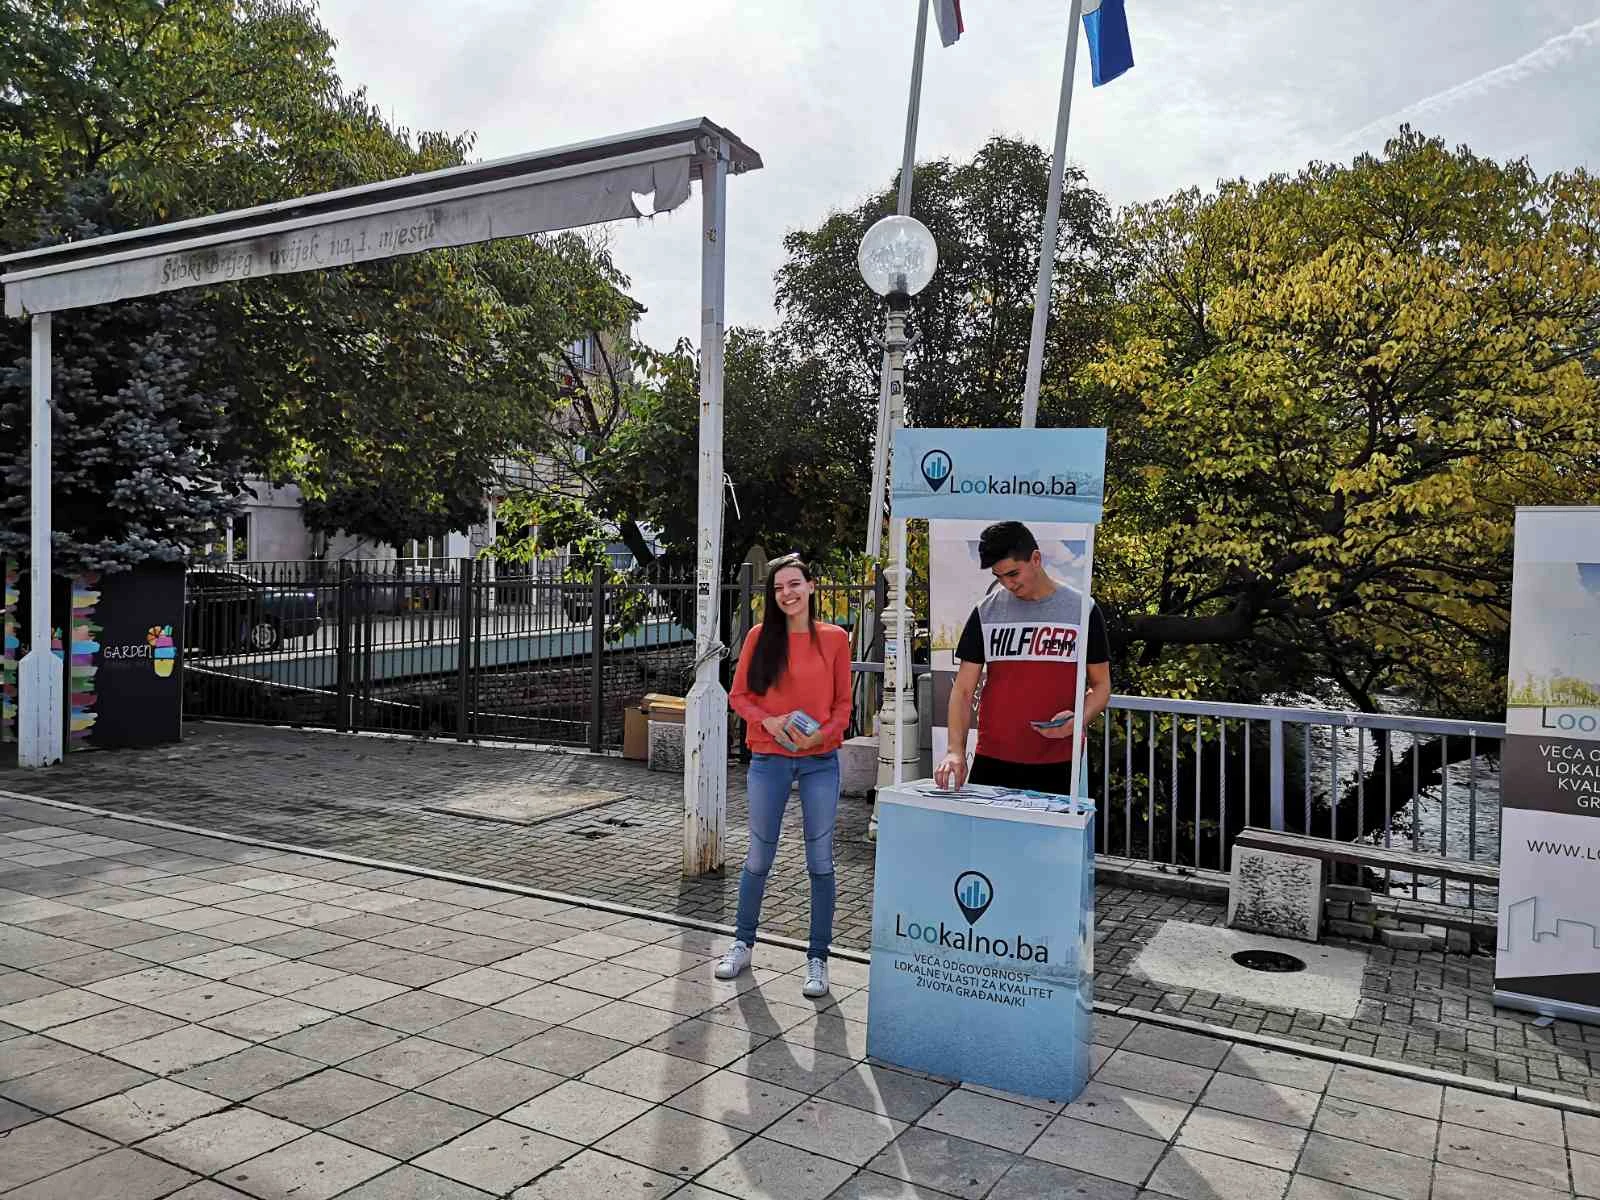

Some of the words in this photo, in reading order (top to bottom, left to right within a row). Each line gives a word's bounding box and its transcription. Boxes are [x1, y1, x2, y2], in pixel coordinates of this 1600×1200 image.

[950, 475, 1077, 496] Lookalno.ba
[990, 626, 1077, 657] HILFIGER
[1539, 744, 1585, 760] VEĆA
[1558, 777, 1600, 793] KVAL
[895, 913, 1049, 964] Lookalno.ba
[894, 959, 941, 979] LOKALNE
[943, 970, 979, 987] VLASTI
[982, 978, 997, 990] ZA
[999, 981, 1054, 1000] KVALITET
[943, 959, 1031, 984] ODGOVORNOST
[916, 975, 954, 994] ŽIVOTA
